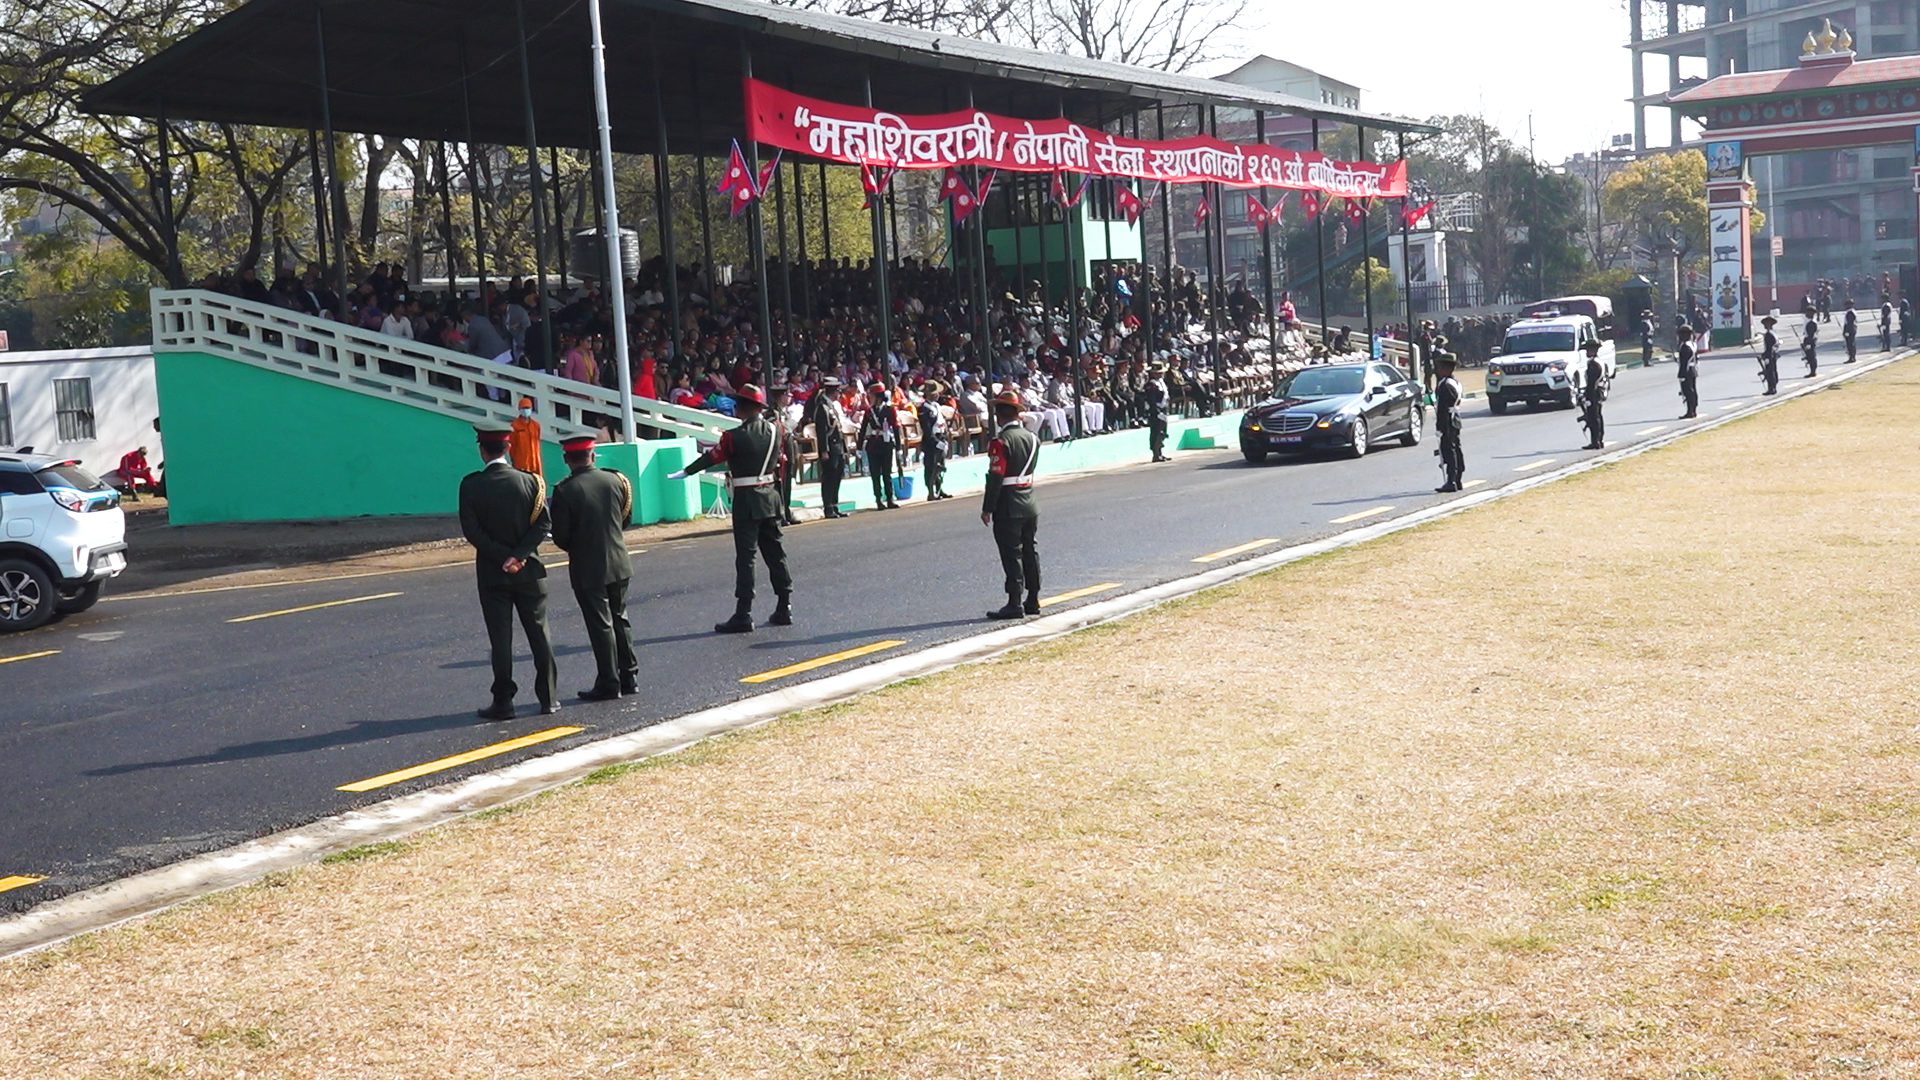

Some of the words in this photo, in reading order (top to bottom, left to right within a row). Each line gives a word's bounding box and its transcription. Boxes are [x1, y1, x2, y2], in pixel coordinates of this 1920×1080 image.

[1013, 121, 1089, 167] नेपाली
[1094, 135, 1146, 177] सेना
[1149, 145, 1244, 180] स्थापनाको
